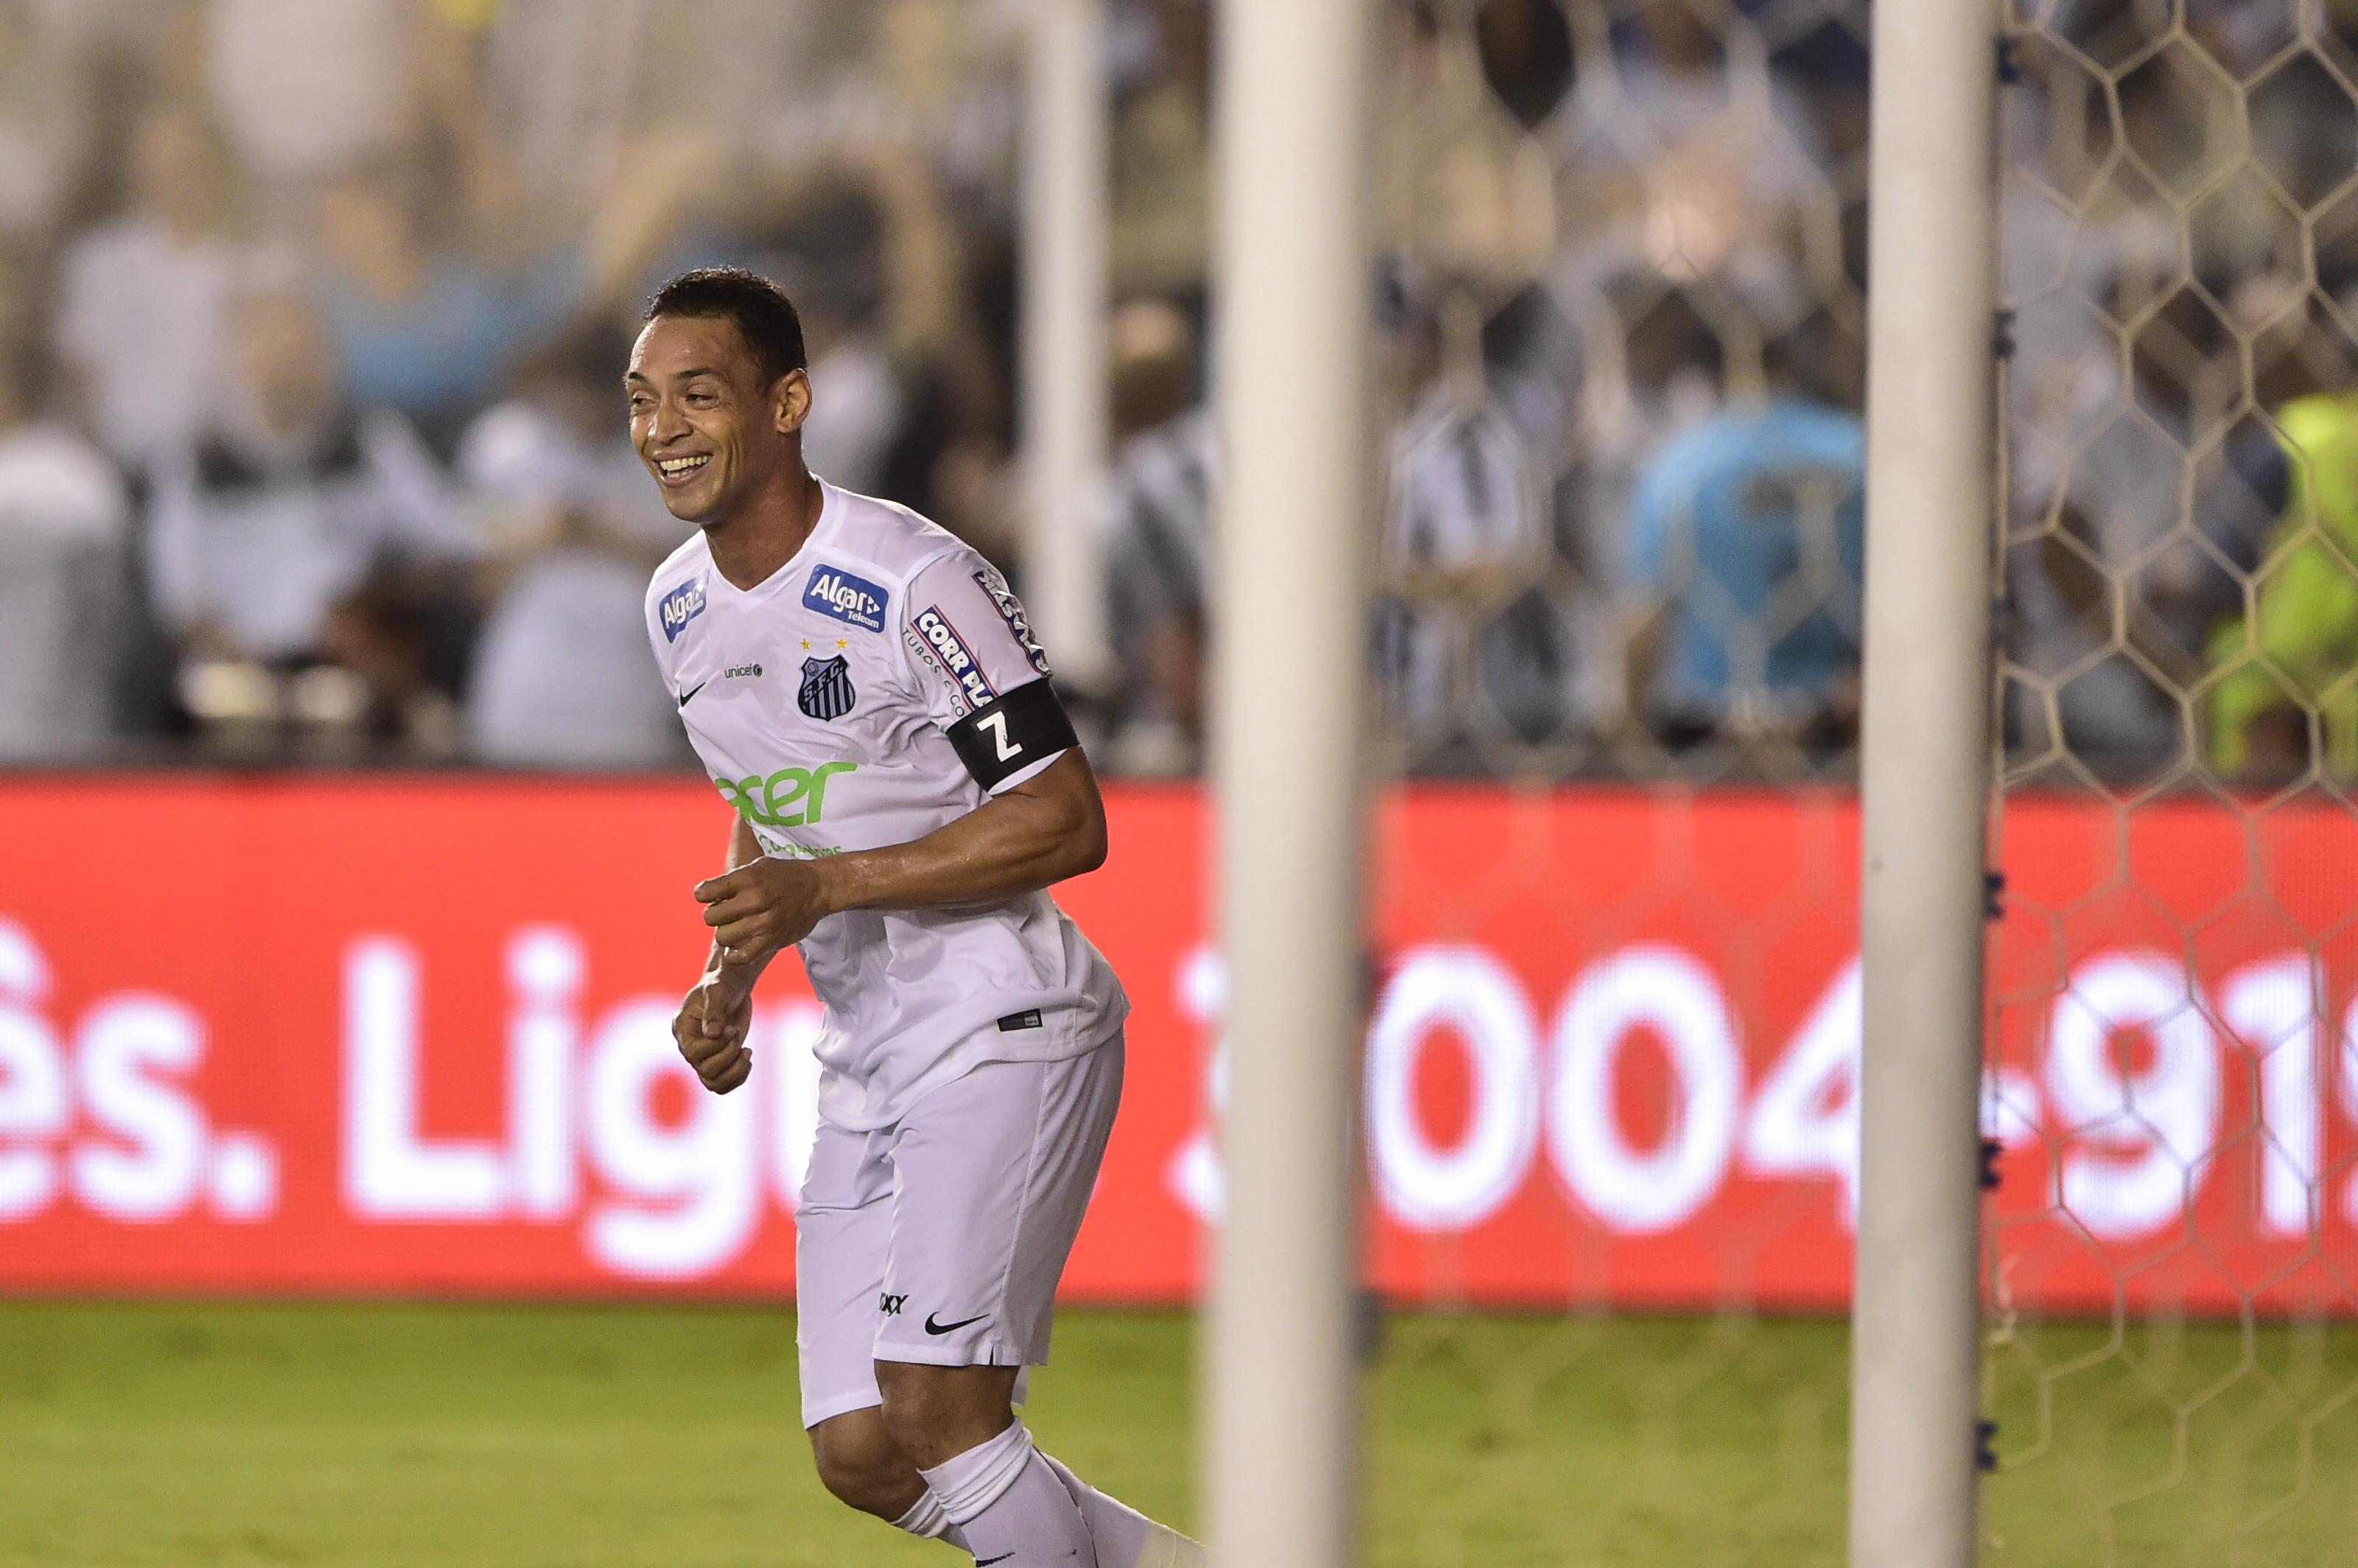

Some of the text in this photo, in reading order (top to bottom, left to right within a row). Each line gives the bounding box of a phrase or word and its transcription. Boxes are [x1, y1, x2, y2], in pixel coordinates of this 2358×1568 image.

[811, 574, 867, 612] Algar
[847, 611, 879, 629] Telecom
[902, 628, 941, 673] TUBOS
[919, 612, 970, 674] CORR
[724, 662, 752, 679] unicef
[976, 711, 1023, 762] Z
